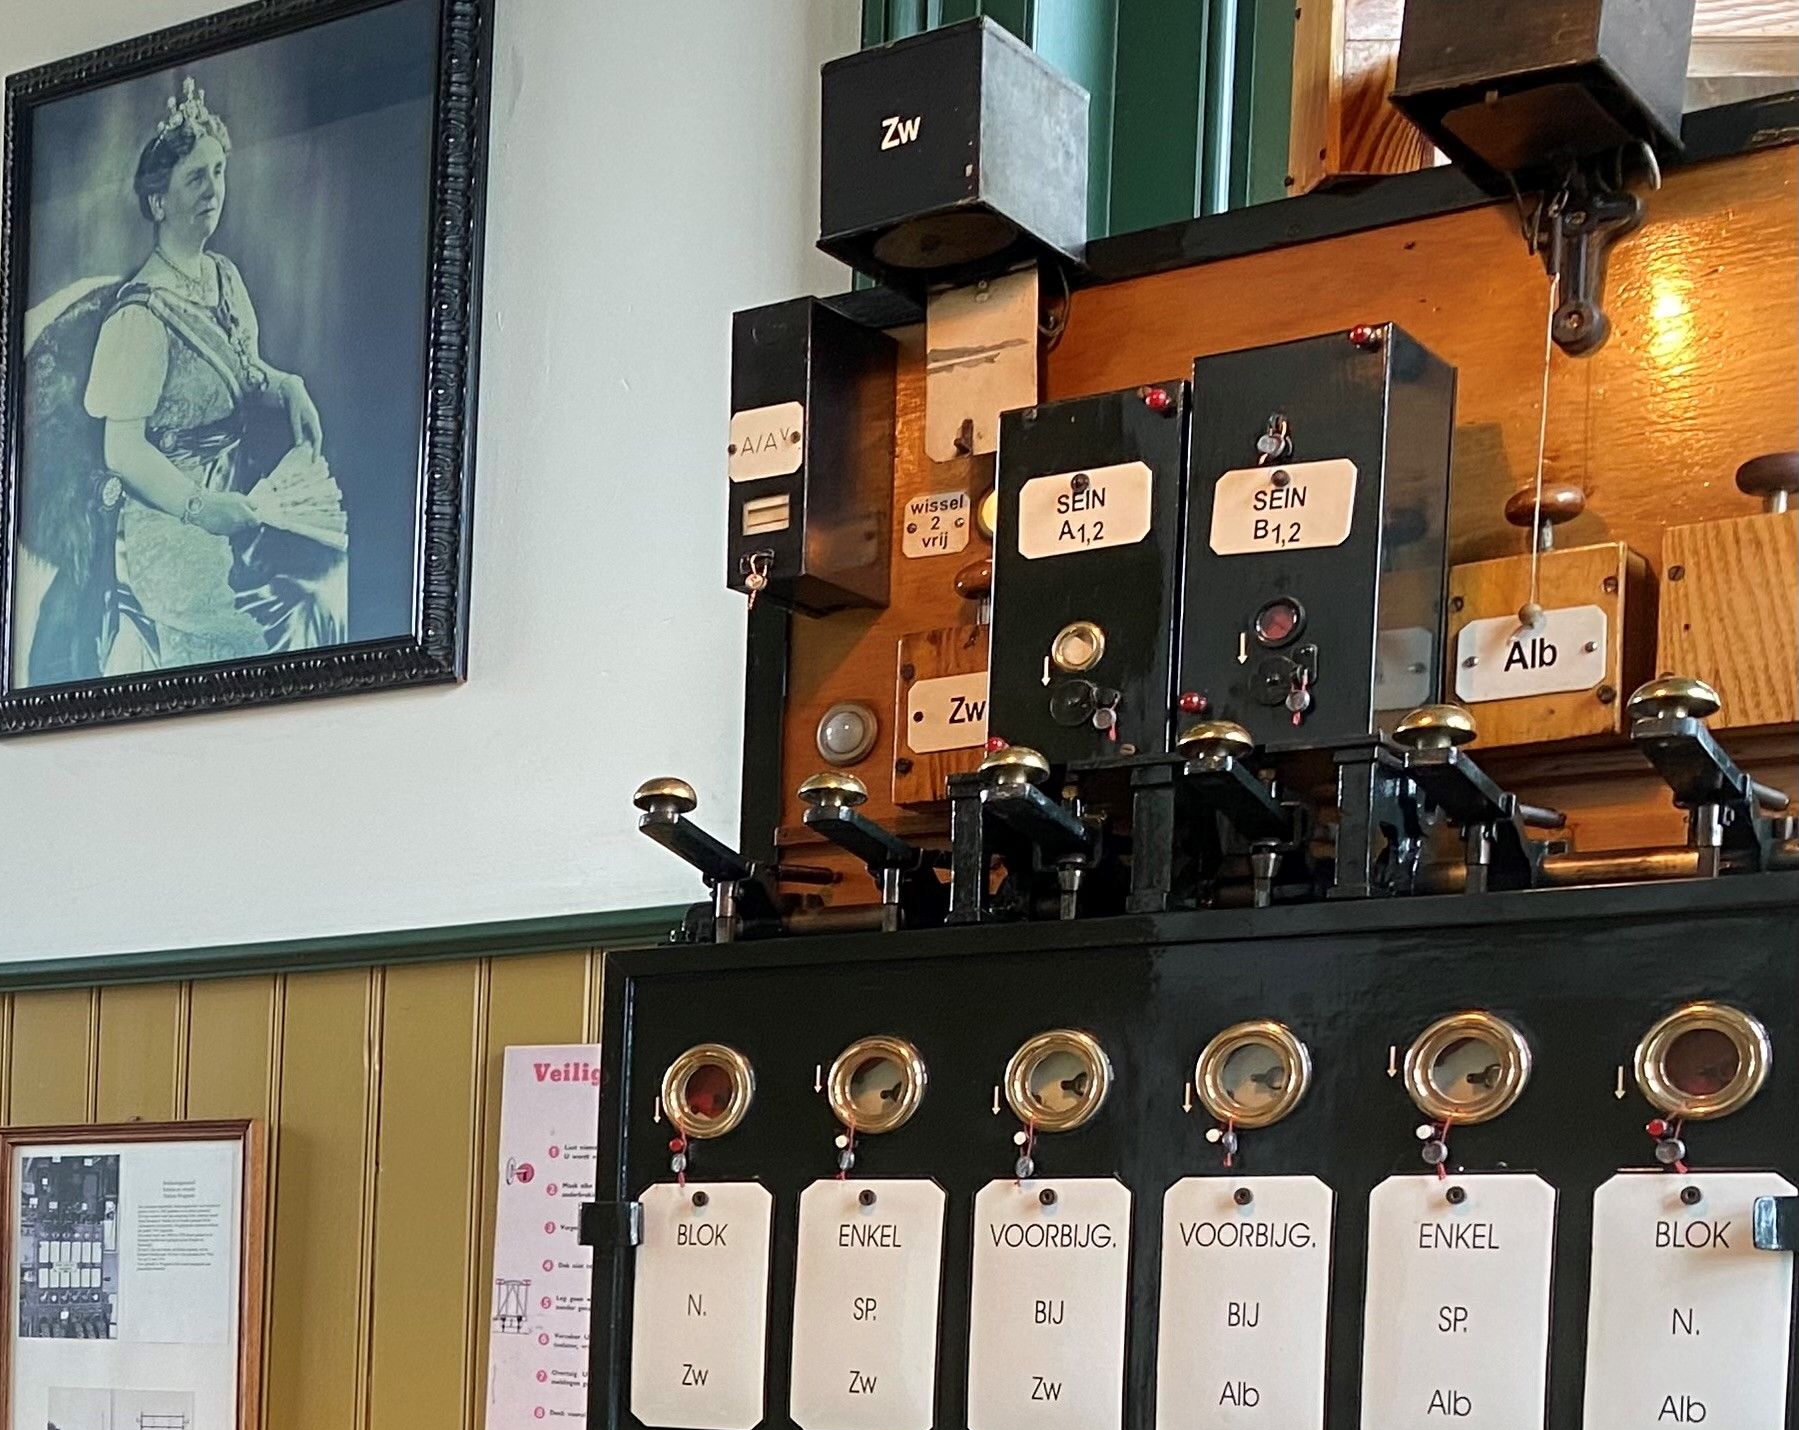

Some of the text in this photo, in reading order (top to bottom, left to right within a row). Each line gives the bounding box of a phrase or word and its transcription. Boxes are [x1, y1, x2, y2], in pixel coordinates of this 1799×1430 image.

[881, 116, 921, 151] Zw
[910, 493, 965, 515] wissel
[1056, 486, 1106, 515] SEIN
[1252, 484, 1307, 512] SEIN
[930, 515, 941, 531] 2
[1058, 519, 1104, 545] A1,2
[1253, 518, 1301, 547] B1,2
[921, 531, 949, 550] vrij
[1503, 637, 1558, 672] Alb
[948, 696, 987, 725] Zw
[677, 1223, 728, 1247] BLOK
[838, 1223, 902, 1248] ENKEL
[989, 1223, 1117, 1249] VOORBIJG.
[1179, 1221, 1316, 1248] VOORBIJG.
[1419, 1222, 1500, 1250] ENKEL
[1655, 1220, 1732, 1250] BLOK
[687, 1293, 707, 1317] N.
[853, 1296, 877, 1321] SP.
[1034, 1299, 1065, 1325] BIJ
[1227, 1301, 1260, 1328] BIJ
[1438, 1305, 1469, 1333] SP.
[1672, 1307, 1700, 1336] N.
[681, 1363, 709, 1387] Zw
[848, 1370, 878, 1394] Zw
[1031, 1376, 1062, 1401] Zw
[1218, 1380, 1260, 1408] Alb
[1427, 1389, 1472, 1417] Alb
[1657, 1395, 1707, 1424] Alb
